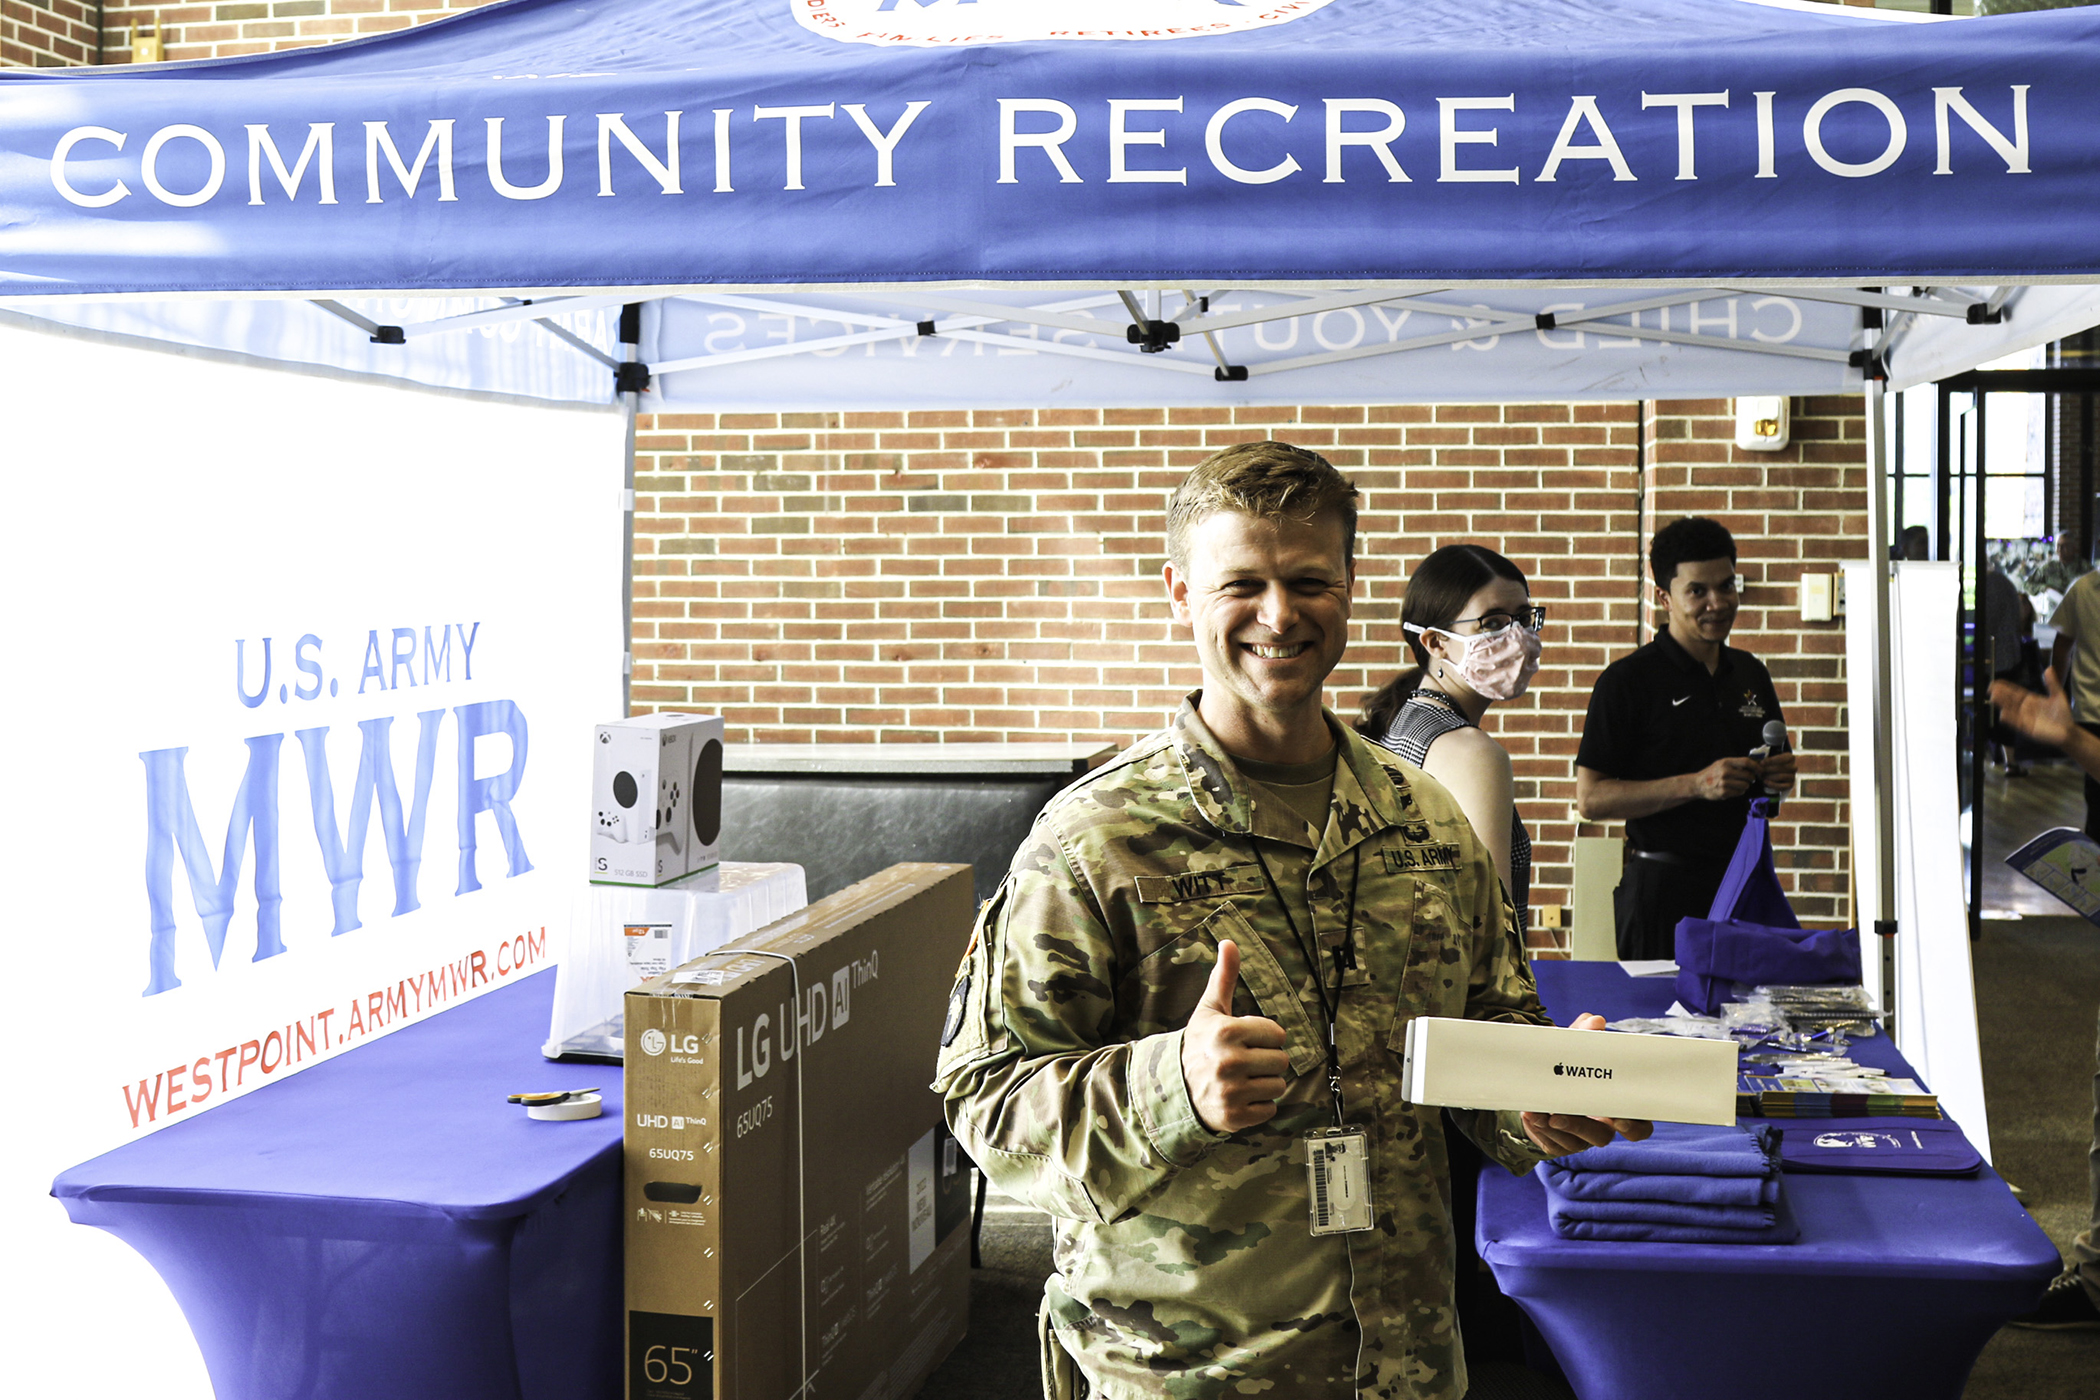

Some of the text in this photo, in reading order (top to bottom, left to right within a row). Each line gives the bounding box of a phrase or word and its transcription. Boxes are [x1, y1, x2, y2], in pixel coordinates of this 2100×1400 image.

[49, 84, 2032, 208] COMMUNITY RECREATION
[235, 622, 480, 708] U.S. ARMY
[139, 699, 535, 997] MWR
[1391, 846, 1453, 868] U.S. ARMY
[1172, 871, 1225, 898] WITT
[122, 926, 546, 1128] WESTPOINT.ARMYMWR.COM
[737, 1013, 770, 1091] LG
[780, 982, 827, 1062] UHD
[852, 950, 878, 989] ThinQ
[671, 1034, 699, 1054] LG
[687, 1057, 704, 1065] Good
[1566, 1065, 1613, 1080] WATCH
[637, 1114, 668, 1129] UHD
[686, 1117, 707, 1126] ThinQ
[737, 1095, 772, 1138] 65UQ75
[649, 1148, 694, 1161] 65UQ75
